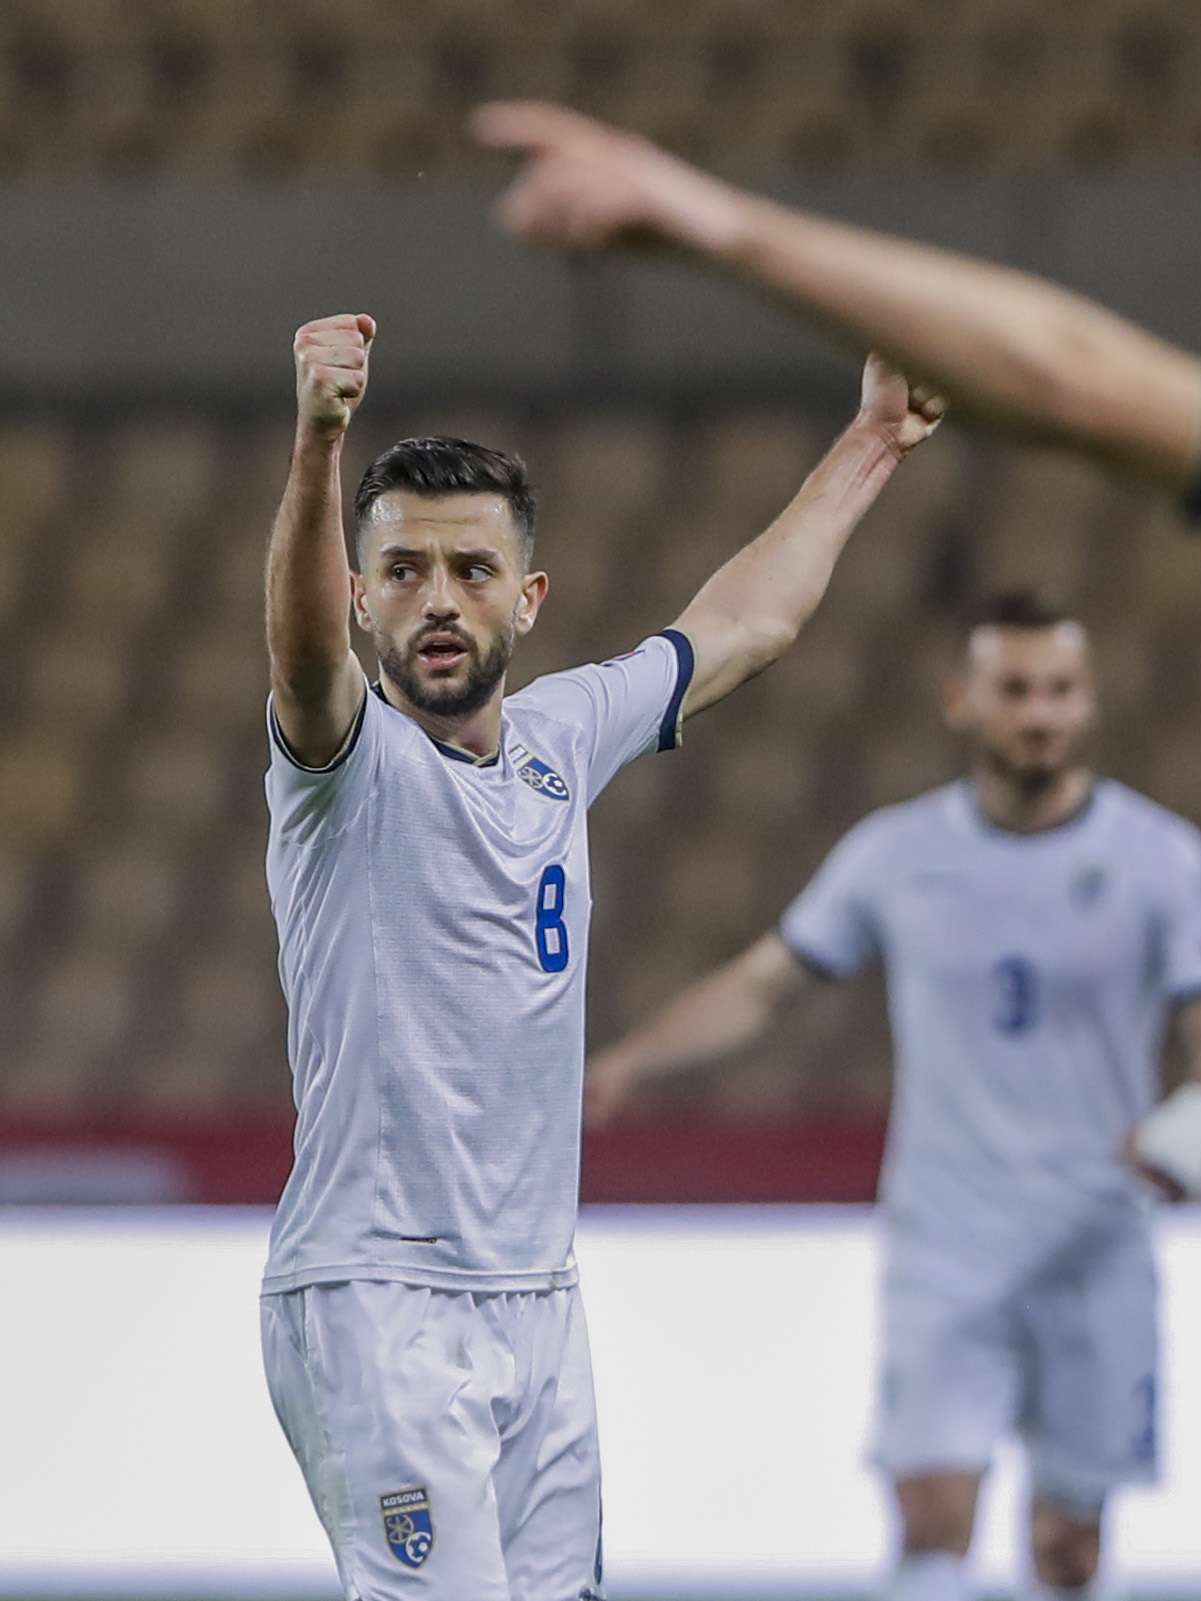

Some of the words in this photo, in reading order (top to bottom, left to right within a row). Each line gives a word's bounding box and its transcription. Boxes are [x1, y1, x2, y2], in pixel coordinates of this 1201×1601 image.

[535, 864, 569, 973] 8
[992, 956, 1039, 1039] 3
[381, 1491, 425, 1507] KOSOVA
